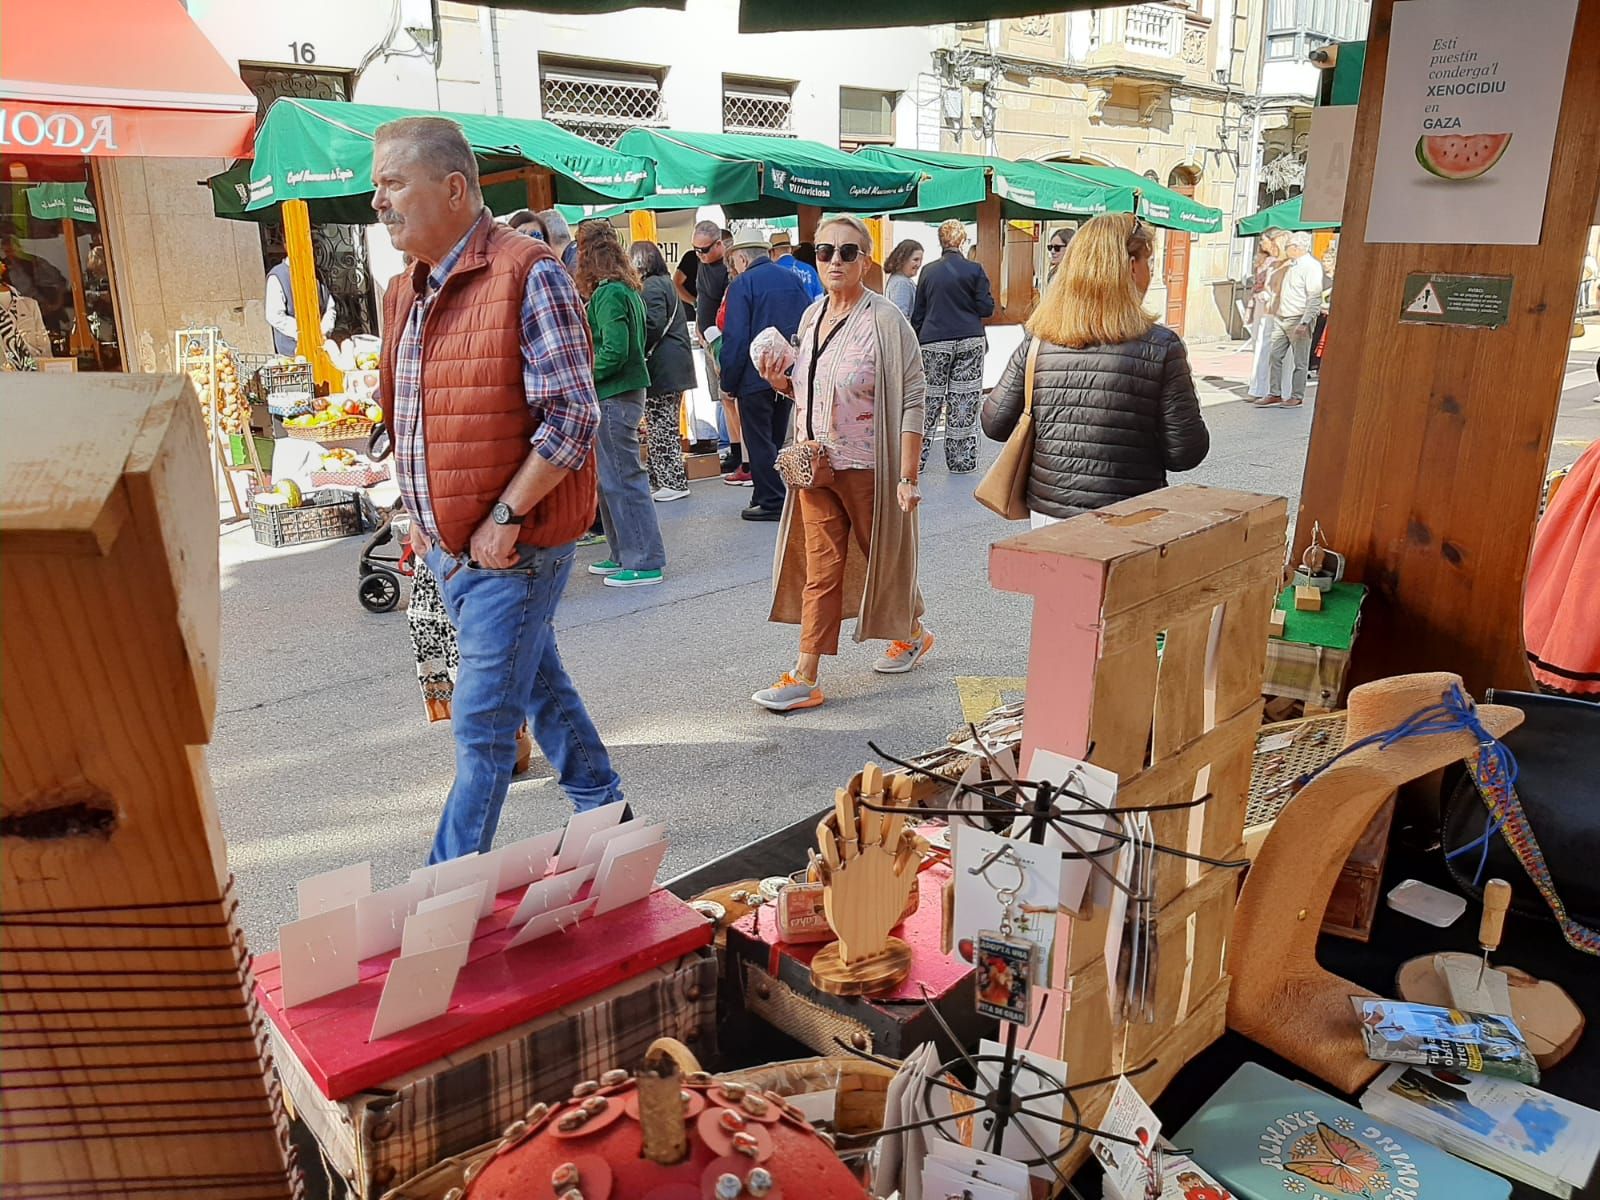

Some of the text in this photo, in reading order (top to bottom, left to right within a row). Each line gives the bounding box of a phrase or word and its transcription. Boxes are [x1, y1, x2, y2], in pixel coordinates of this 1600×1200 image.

[1432, 36, 1458, 51] Esti
[288, 41, 316, 64] 16
[1426, 81, 1506, 97] XENOCIDIU
[1424, 104, 1440, 113] en
[1423, 117, 1462, 129] GAZA
[789, 182, 831, 197] Villaviciosa
[1259, 1110, 1321, 1171] ALWAYS
